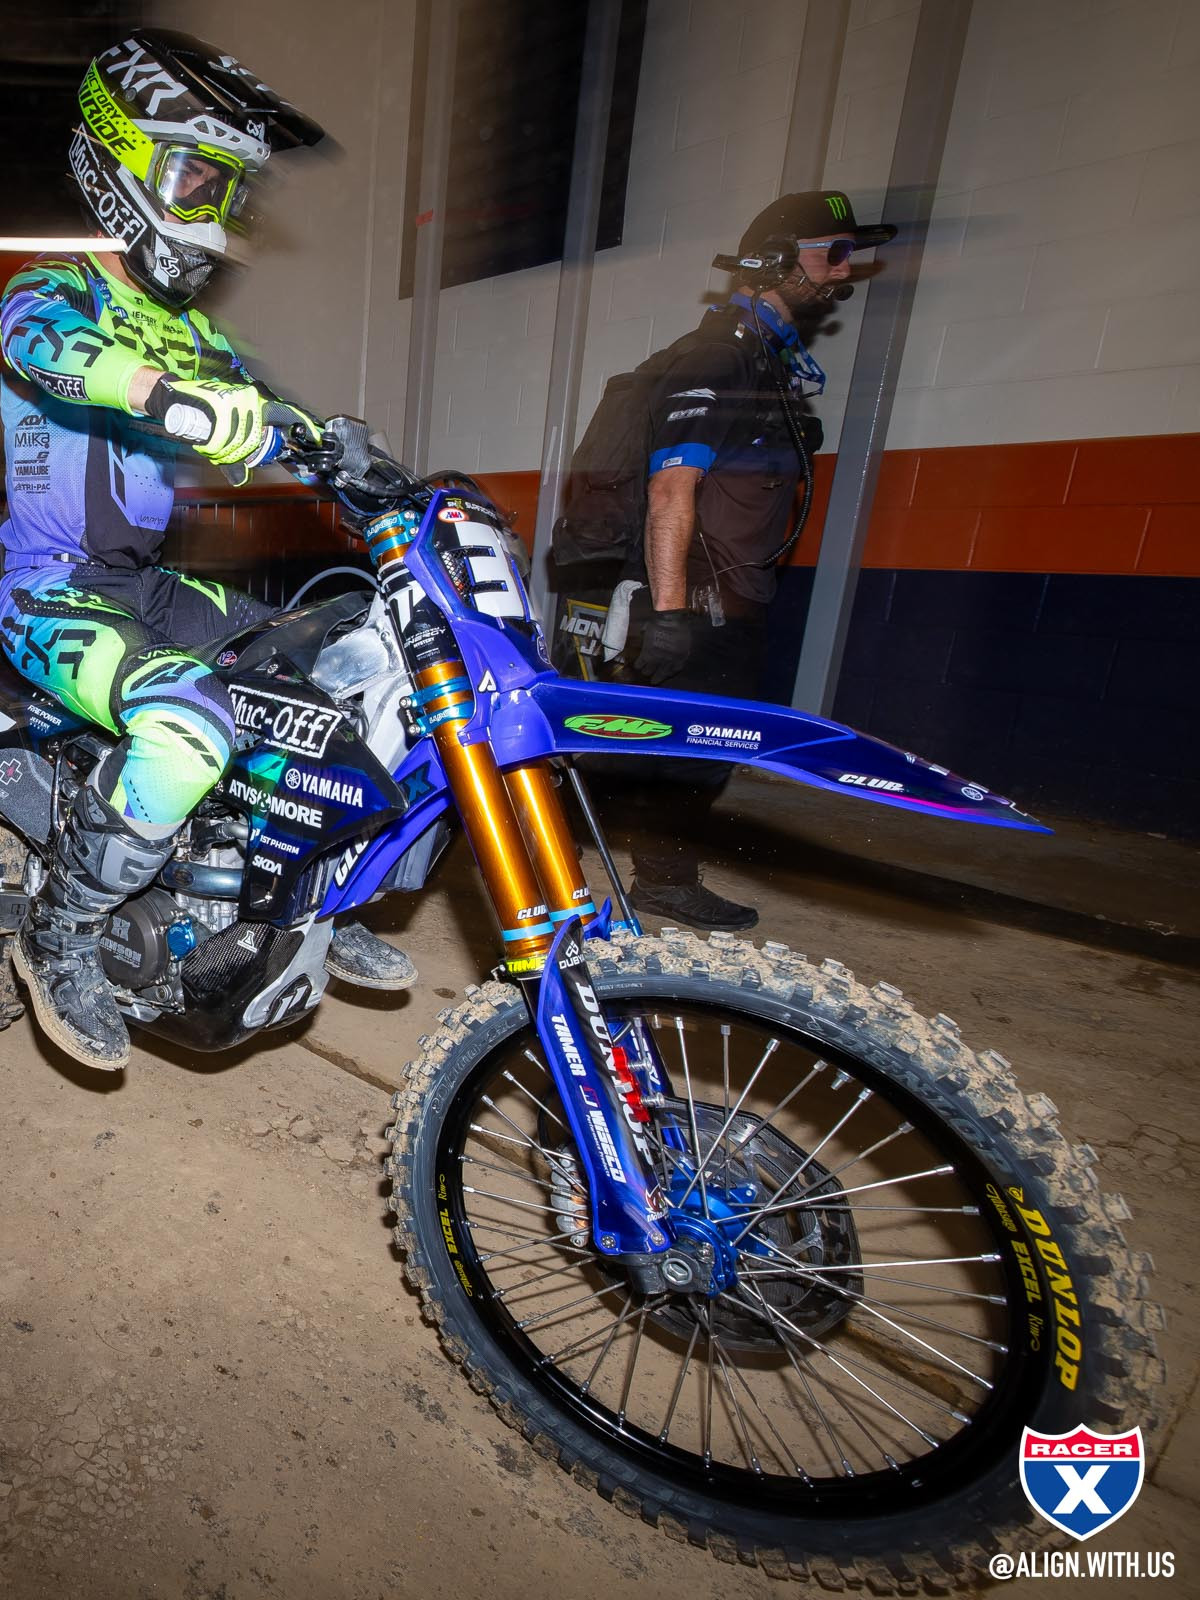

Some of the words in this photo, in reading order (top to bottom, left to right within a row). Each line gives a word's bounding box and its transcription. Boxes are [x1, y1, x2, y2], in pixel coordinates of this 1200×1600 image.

[15, 465, 50, 476] YAMALUBE
[27, 704, 62, 726] FIREPOWER
[231, 692, 330, 749] Muc-Off
[564, 716, 672, 735] FMF
[686, 737, 723, 747] FINANCIAL
[725, 741, 760, 750] SERVICES
[705, 726, 761, 741] YAMAHA
[302, 773, 364, 808] YAMAHA
[838, 774, 904, 792] CLUB
[252, 855, 282, 876] SKDA
[552, 1014, 587, 1077] TAMER
[589, 1110, 626, 1184] WISECO
[440, 1208, 458, 1254] EXCEL
[1011, 1239, 1042, 1303] EXCEL
[1018, 1208, 1082, 1392] DUNLOP
